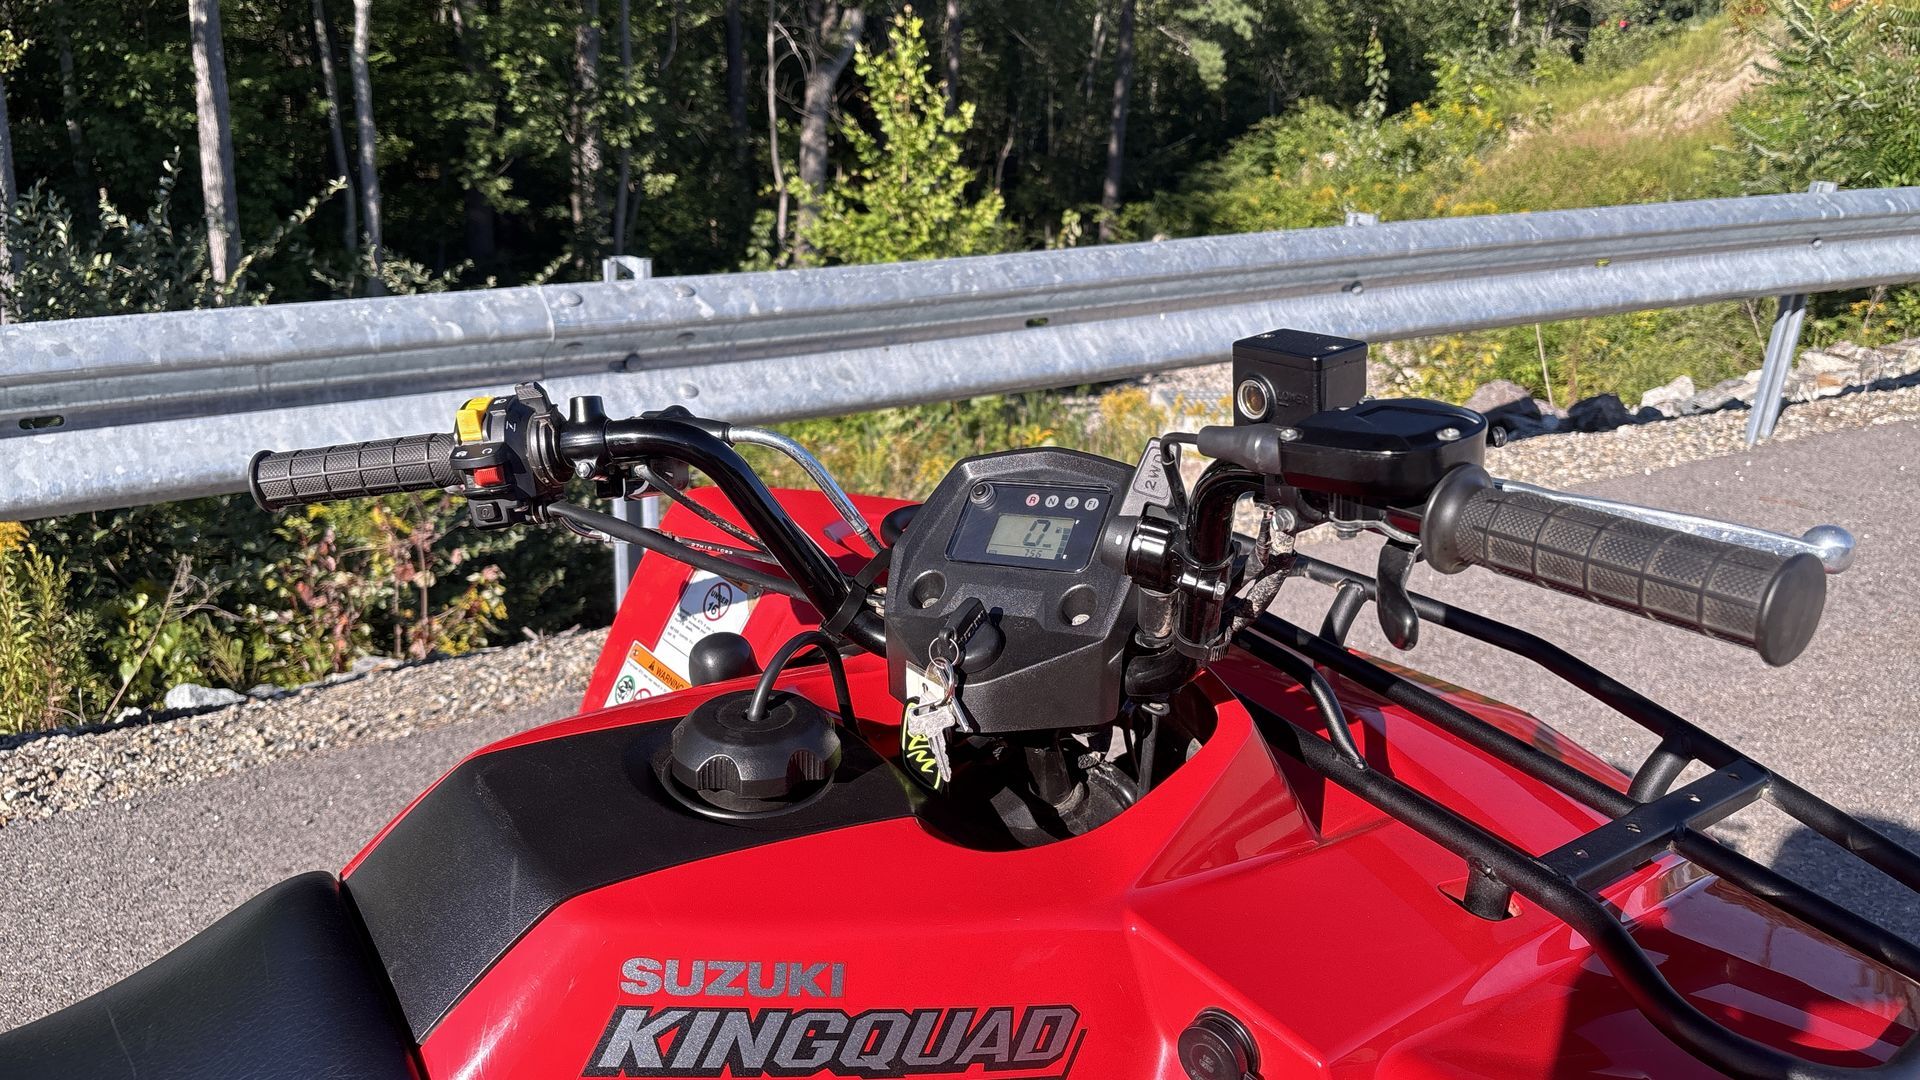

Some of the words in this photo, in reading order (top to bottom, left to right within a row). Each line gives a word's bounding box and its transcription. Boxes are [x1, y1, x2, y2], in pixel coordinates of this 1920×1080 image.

[707, 602, 720, 615] 16
[620, 957, 845, 999] SUZUKI
[594, 1005, 1078, 1071] KINGQUAD
